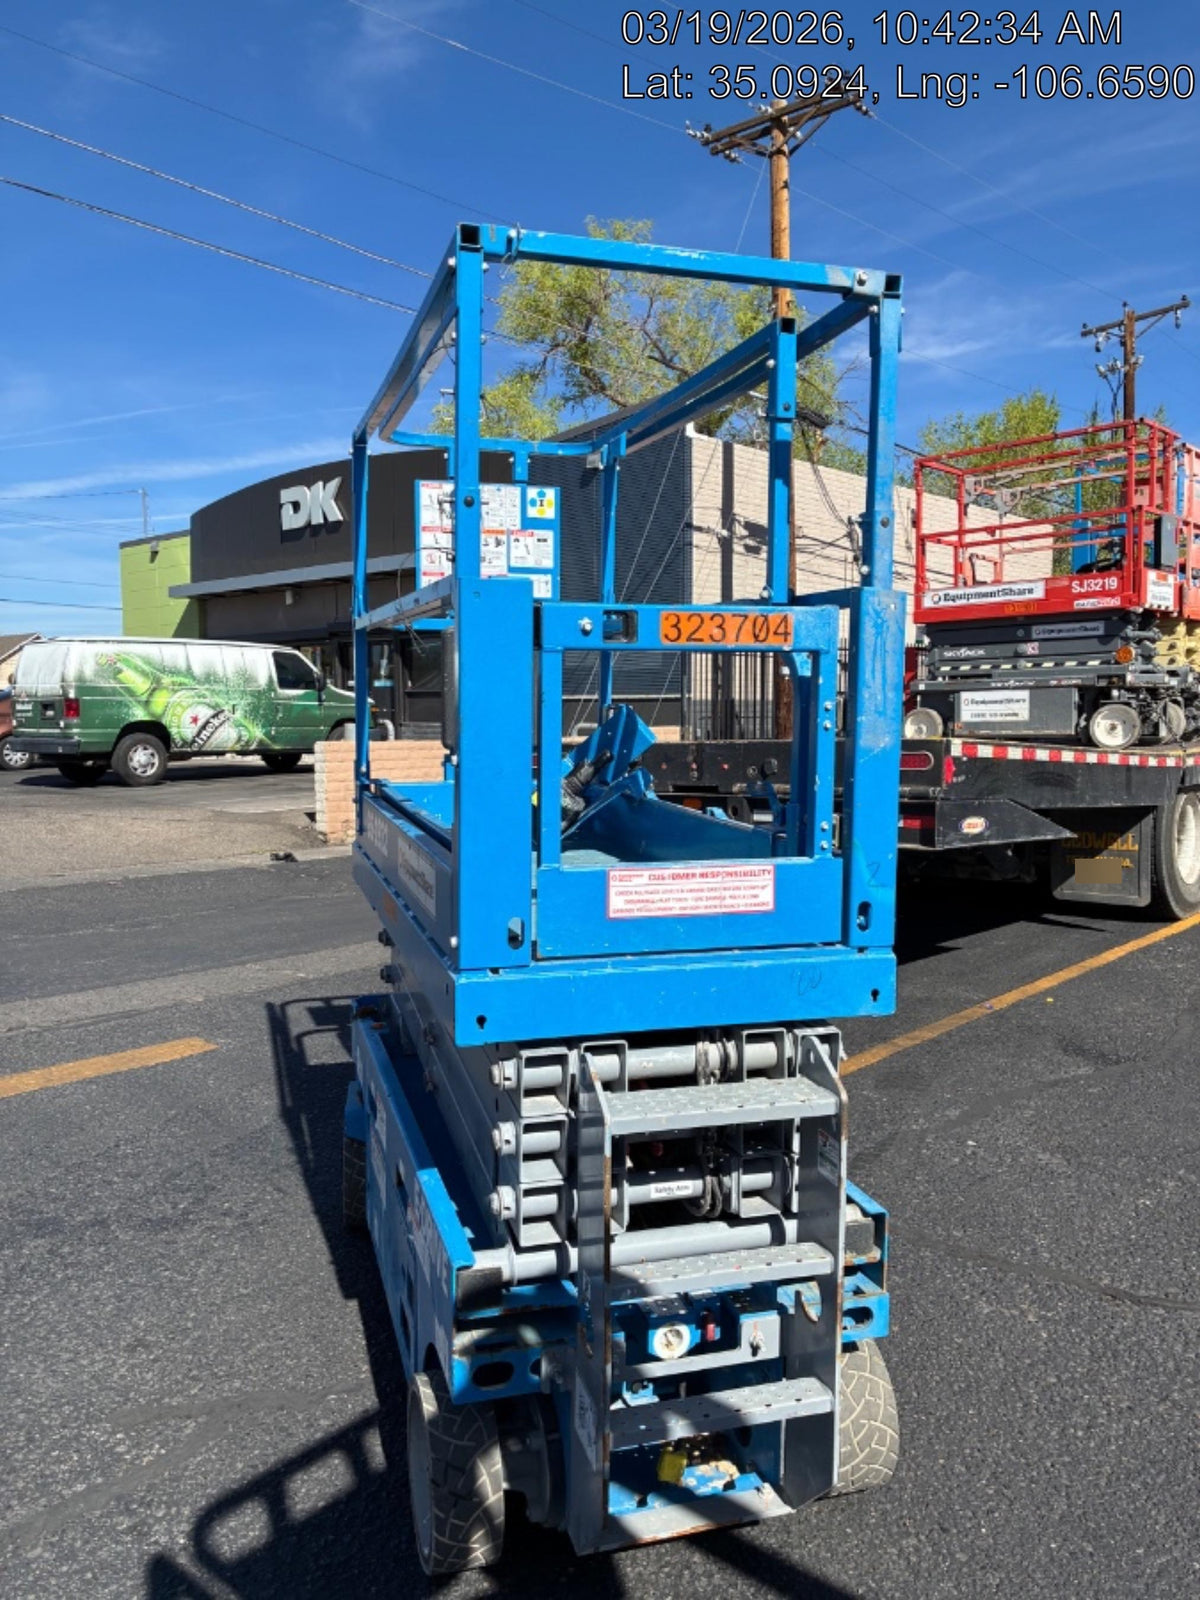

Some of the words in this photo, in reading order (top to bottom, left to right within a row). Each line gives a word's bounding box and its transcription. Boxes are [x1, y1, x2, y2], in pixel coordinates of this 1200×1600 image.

[280, 476, 344, 531] DK
[943, 587, 1034, 603] EquipmentShare
[1071, 577, 1118, 594] SJ3219
[664, 612, 791, 643] 323704
